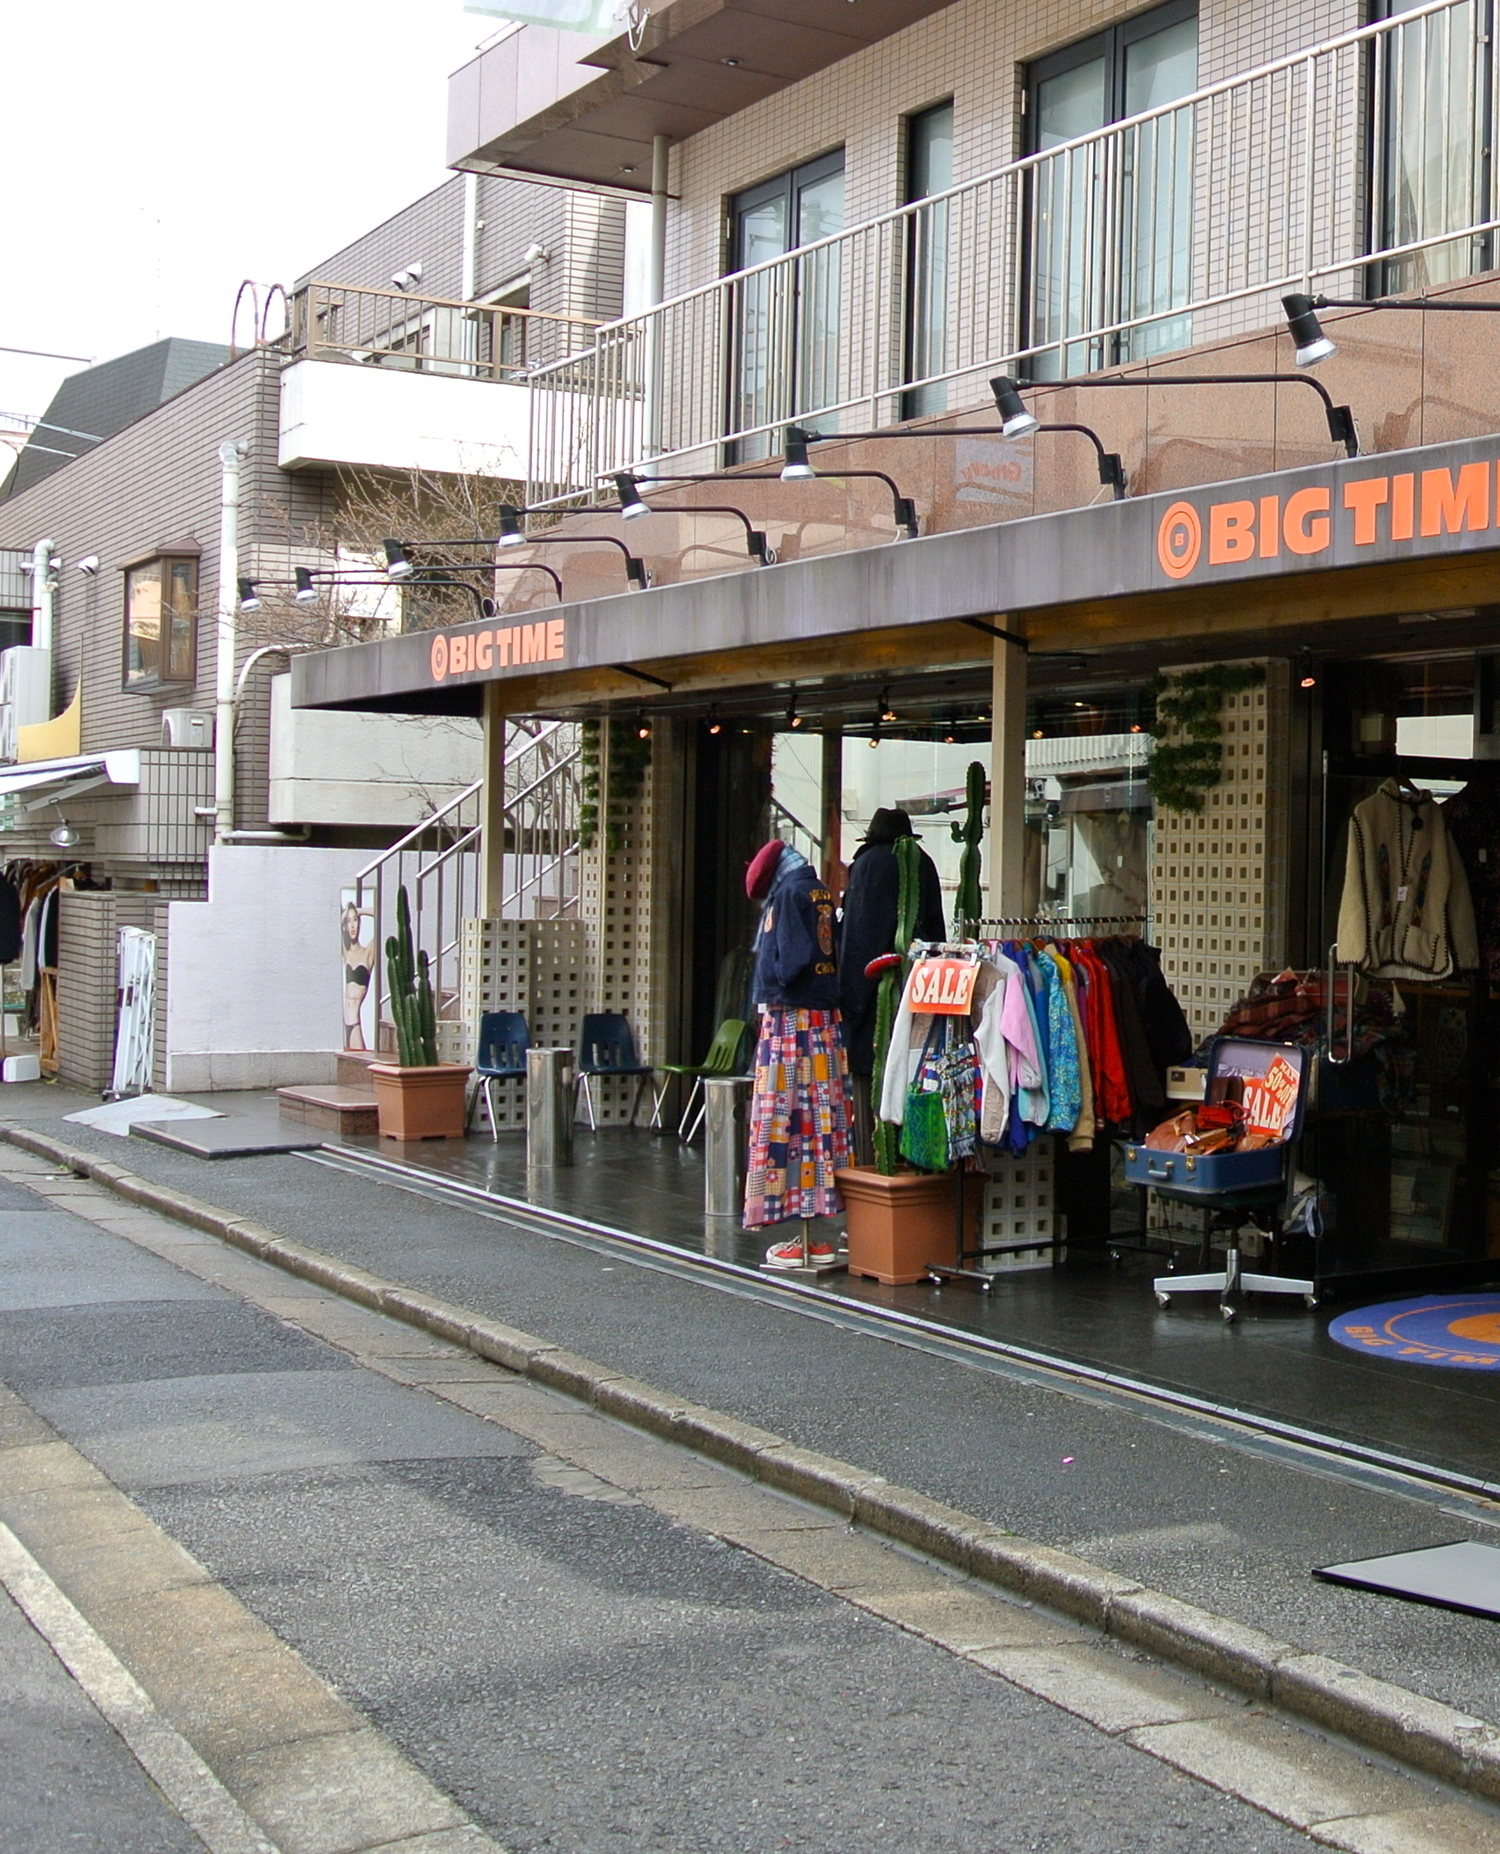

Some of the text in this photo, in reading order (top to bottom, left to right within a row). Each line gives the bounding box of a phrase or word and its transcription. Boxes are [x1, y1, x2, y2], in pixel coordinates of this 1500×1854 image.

[1209, 487, 1331, 566] BIG
[449, 619, 565, 674] BIG TIME
[911, 967, 972, 1005] SALE
[1243, 1086, 1281, 1130] SALE
[1344, 1326, 1396, 1346] BIG
